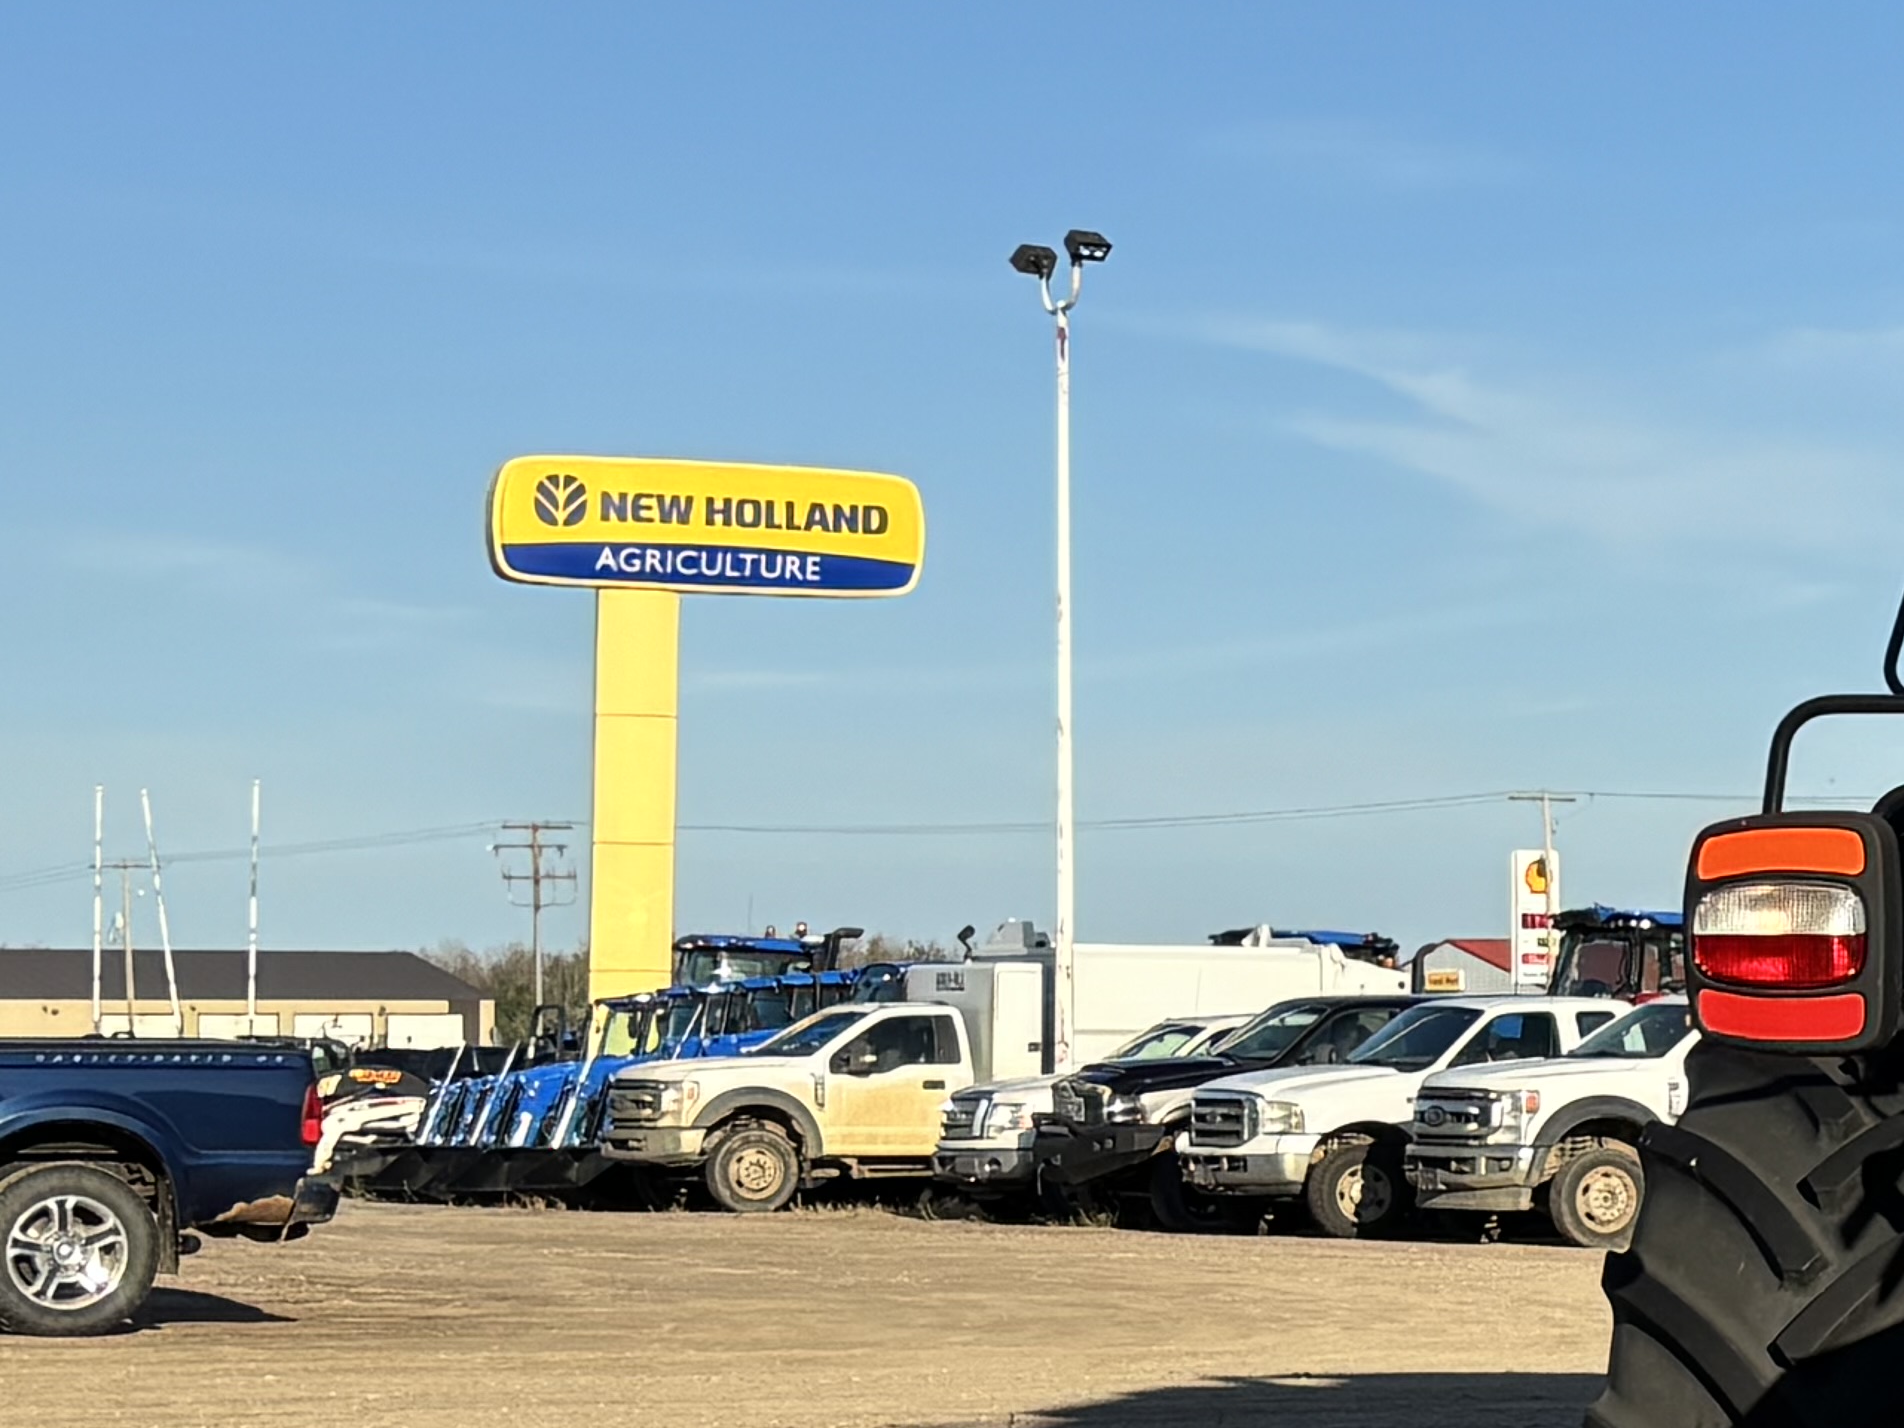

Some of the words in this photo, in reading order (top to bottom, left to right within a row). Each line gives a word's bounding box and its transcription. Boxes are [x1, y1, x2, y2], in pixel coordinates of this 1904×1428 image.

[600, 489, 693, 525] NEW
[704, 496, 889, 535] HOLLAND
[595, 545, 822, 581] AGRICULTURE
